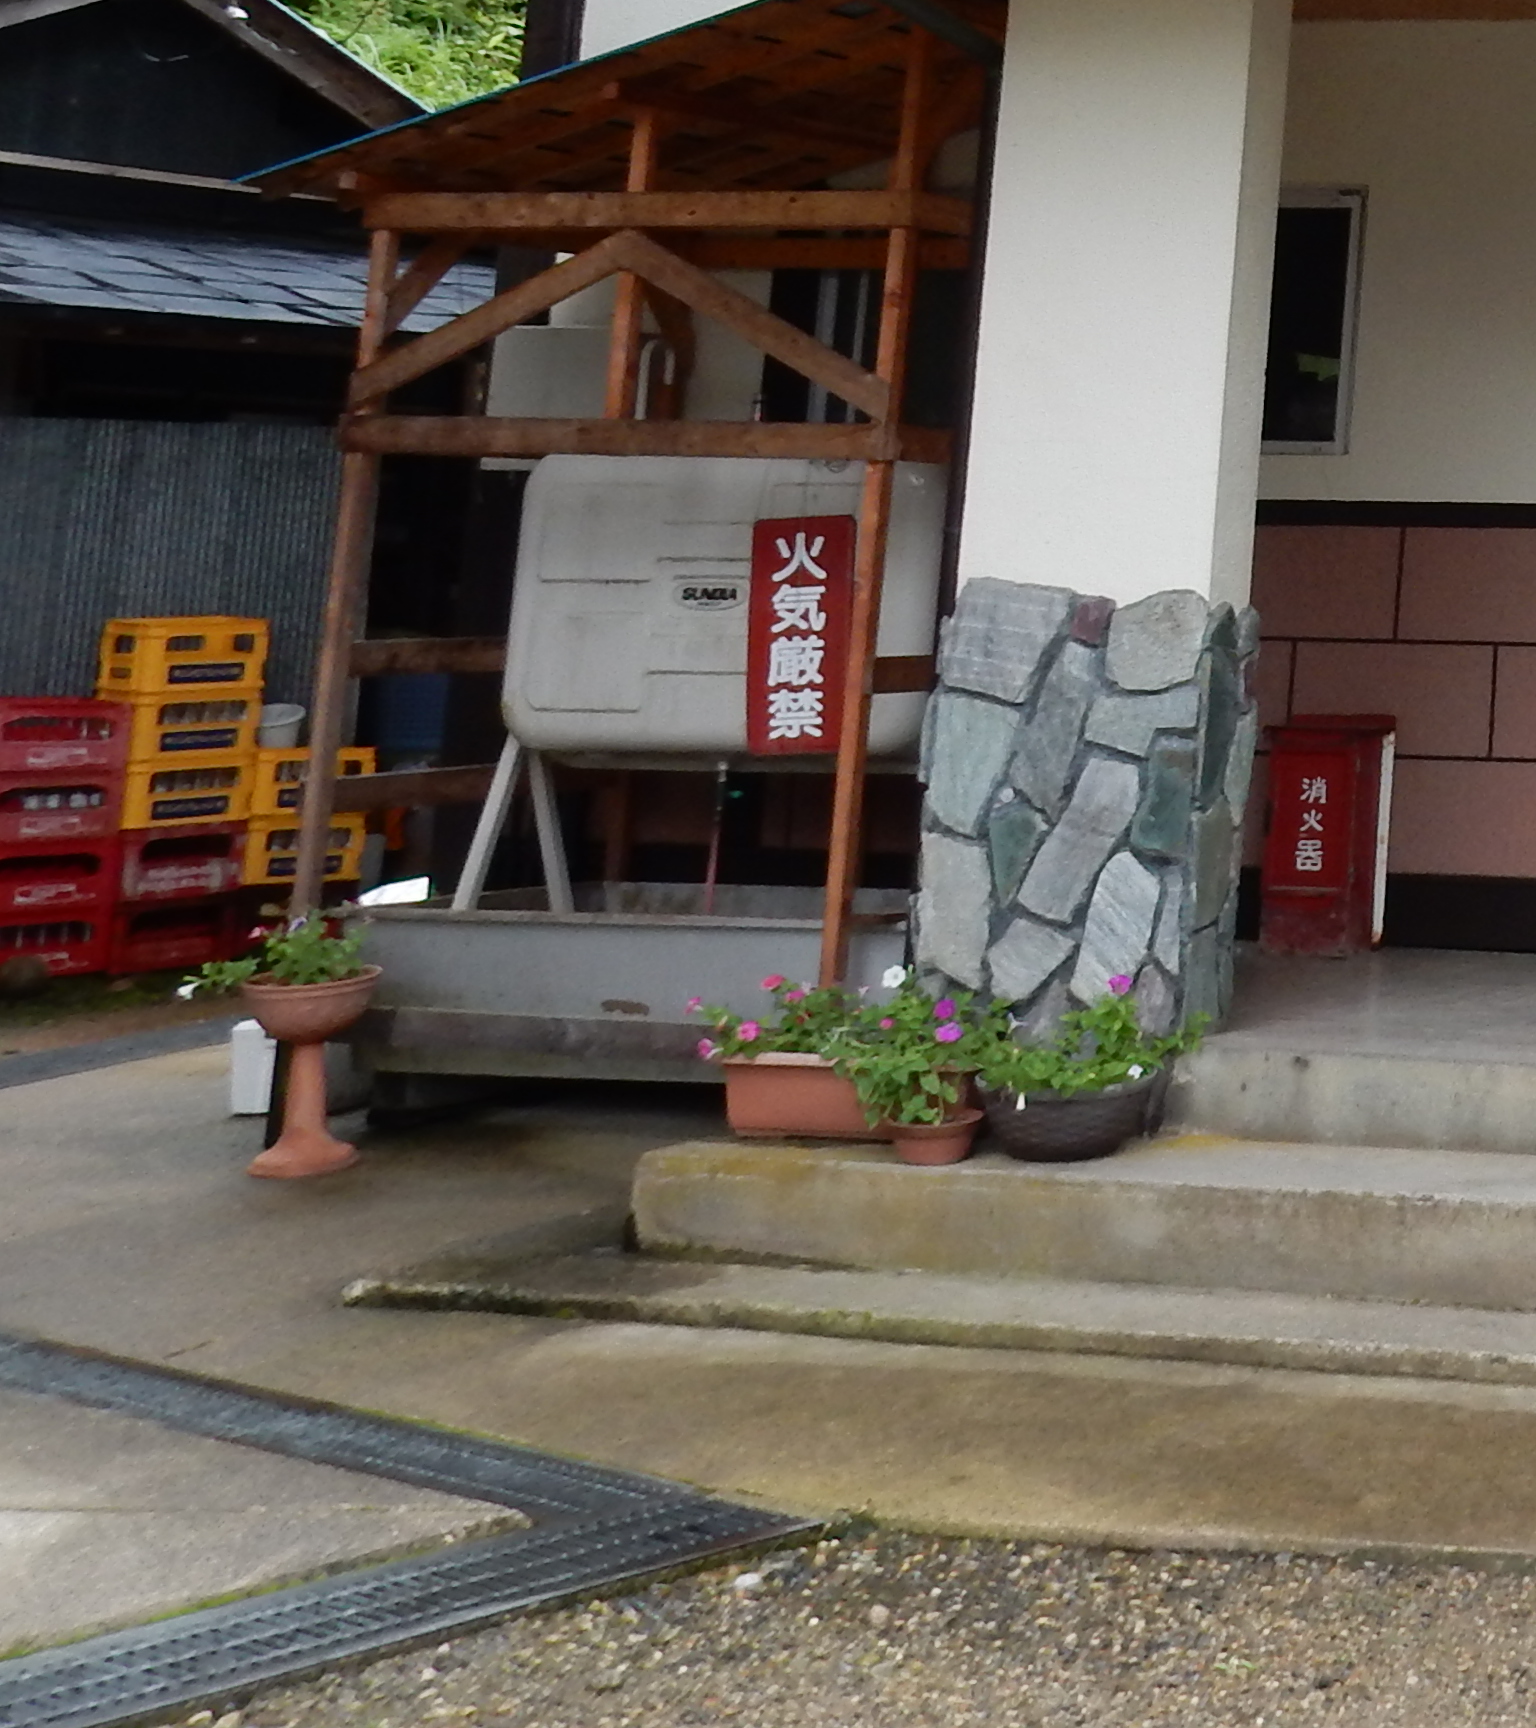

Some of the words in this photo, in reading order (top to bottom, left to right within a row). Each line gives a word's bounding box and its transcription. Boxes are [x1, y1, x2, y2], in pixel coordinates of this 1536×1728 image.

[765, 531, 828, 741] 火気厳禁
[1294, 775, 1328, 872] 消火器
